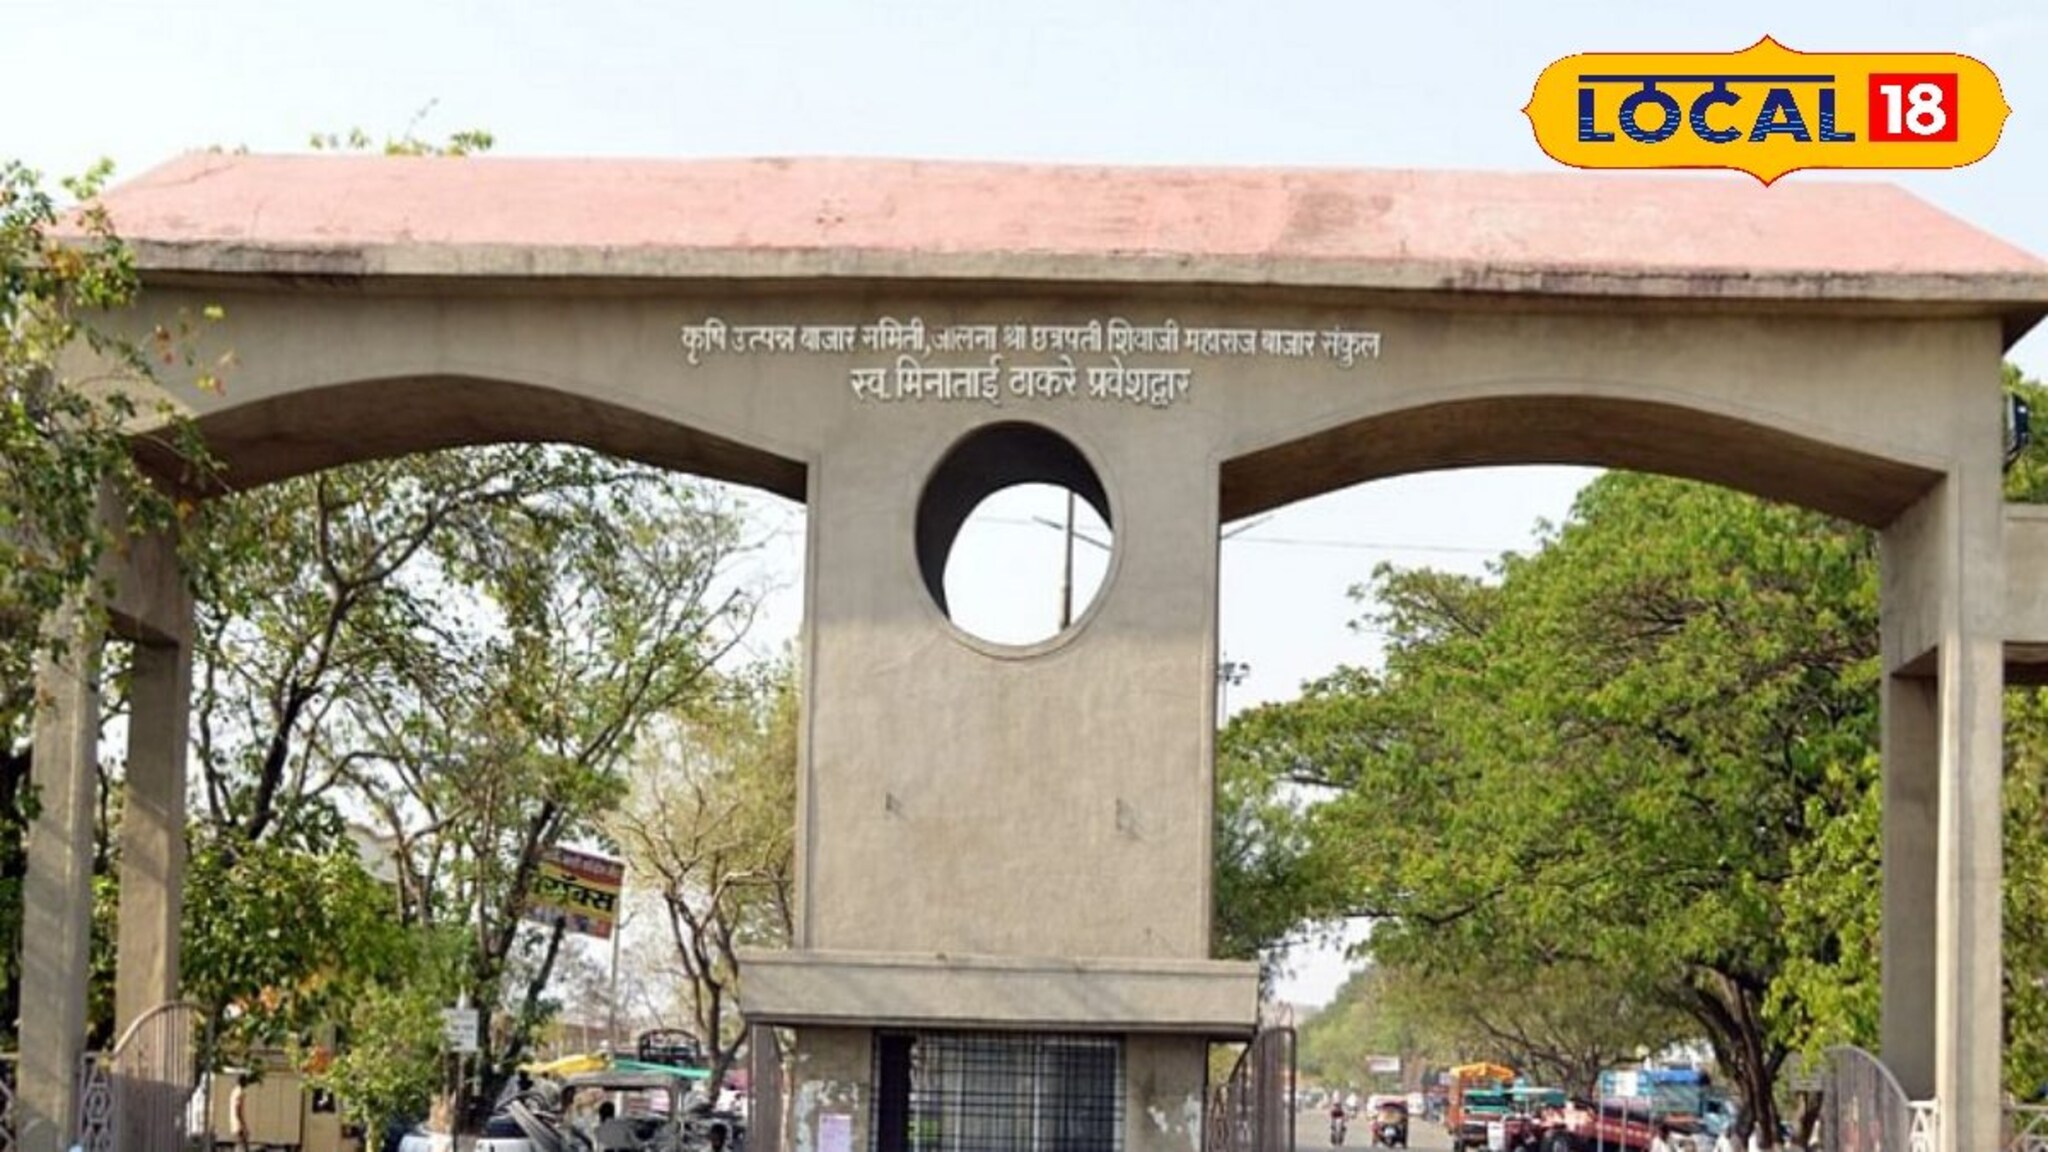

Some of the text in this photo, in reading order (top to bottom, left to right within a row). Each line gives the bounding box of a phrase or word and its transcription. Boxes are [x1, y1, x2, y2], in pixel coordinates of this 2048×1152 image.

[681, 317, 726, 365] कृषि
[731, 325, 796, 352] उत्पन्न
[800, 325, 857, 352] बाजार
[1031, 319, 1102, 352] छत्रपती
[1108, 317, 1179, 355] शिवाजी
[1184, 327, 1257, 355] महाराज
[1261, 328, 1317, 356] बाजार
[1321, 325, 1381, 367] संकुल
[895, 354, 1003, 406] मिनाताई
[1009, 354, 1077, 397] ठाकरे
[1087, 356, 1191, 408] प्रवेशद्वार
